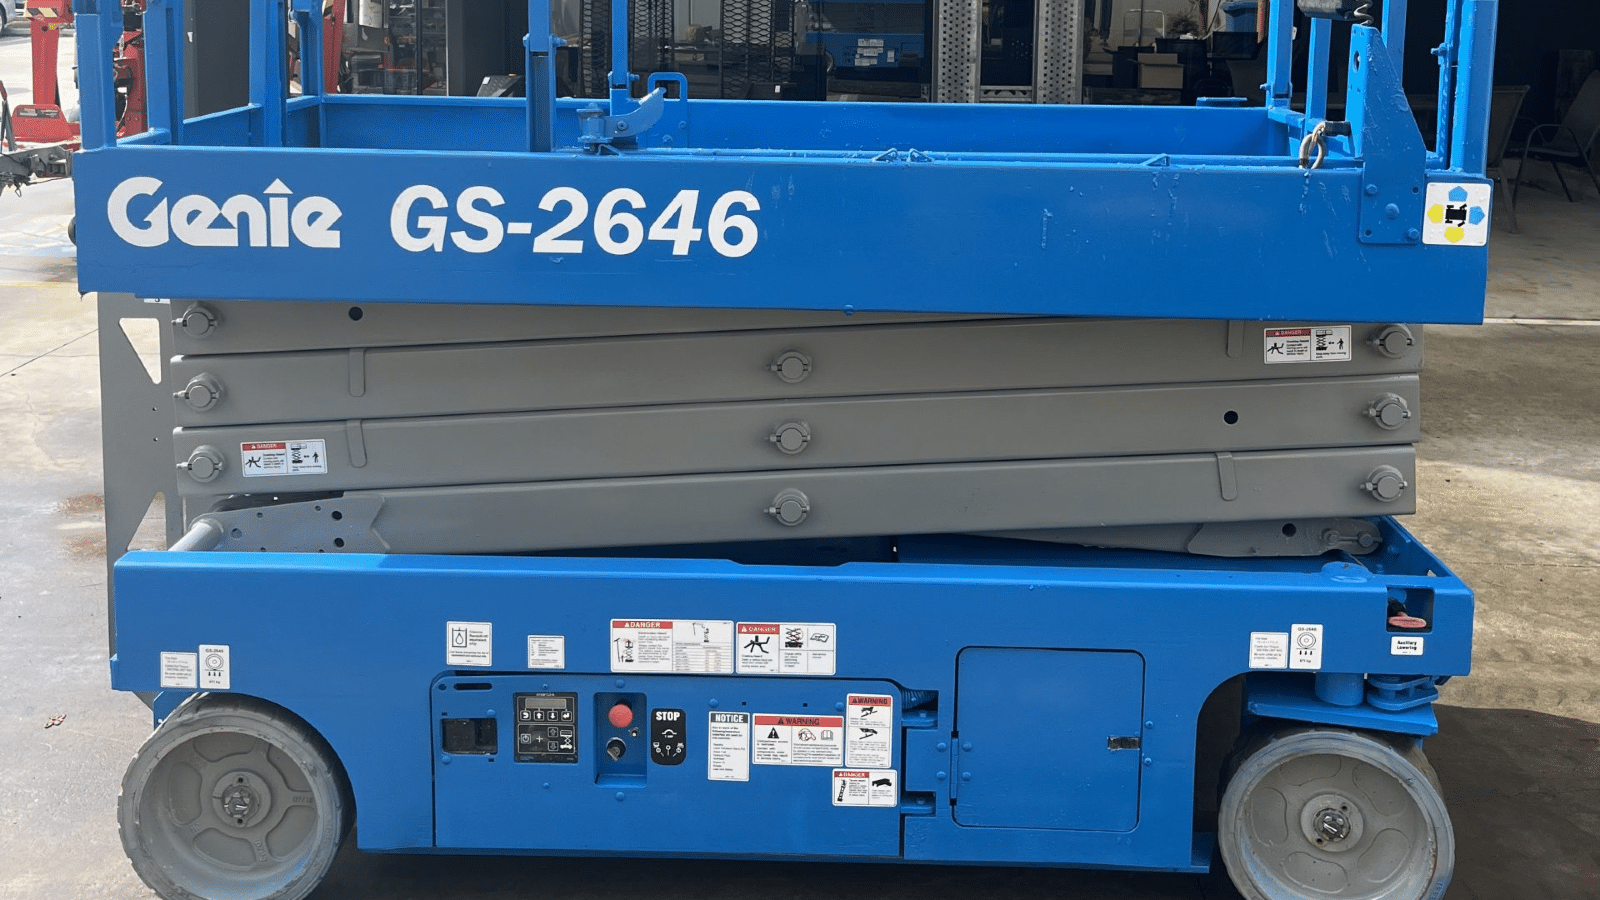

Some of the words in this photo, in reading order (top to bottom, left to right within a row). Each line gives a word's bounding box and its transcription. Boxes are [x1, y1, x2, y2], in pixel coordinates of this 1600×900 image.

[108, 176, 341, 248] Genie
[390, 184, 760, 258] GS-2646
[857, 697, 888, 705] WARNING
[655, 711, 681, 721] STOP
[715, 713, 744, 723] NOTICE
[786, 718, 820, 726] WARNING
